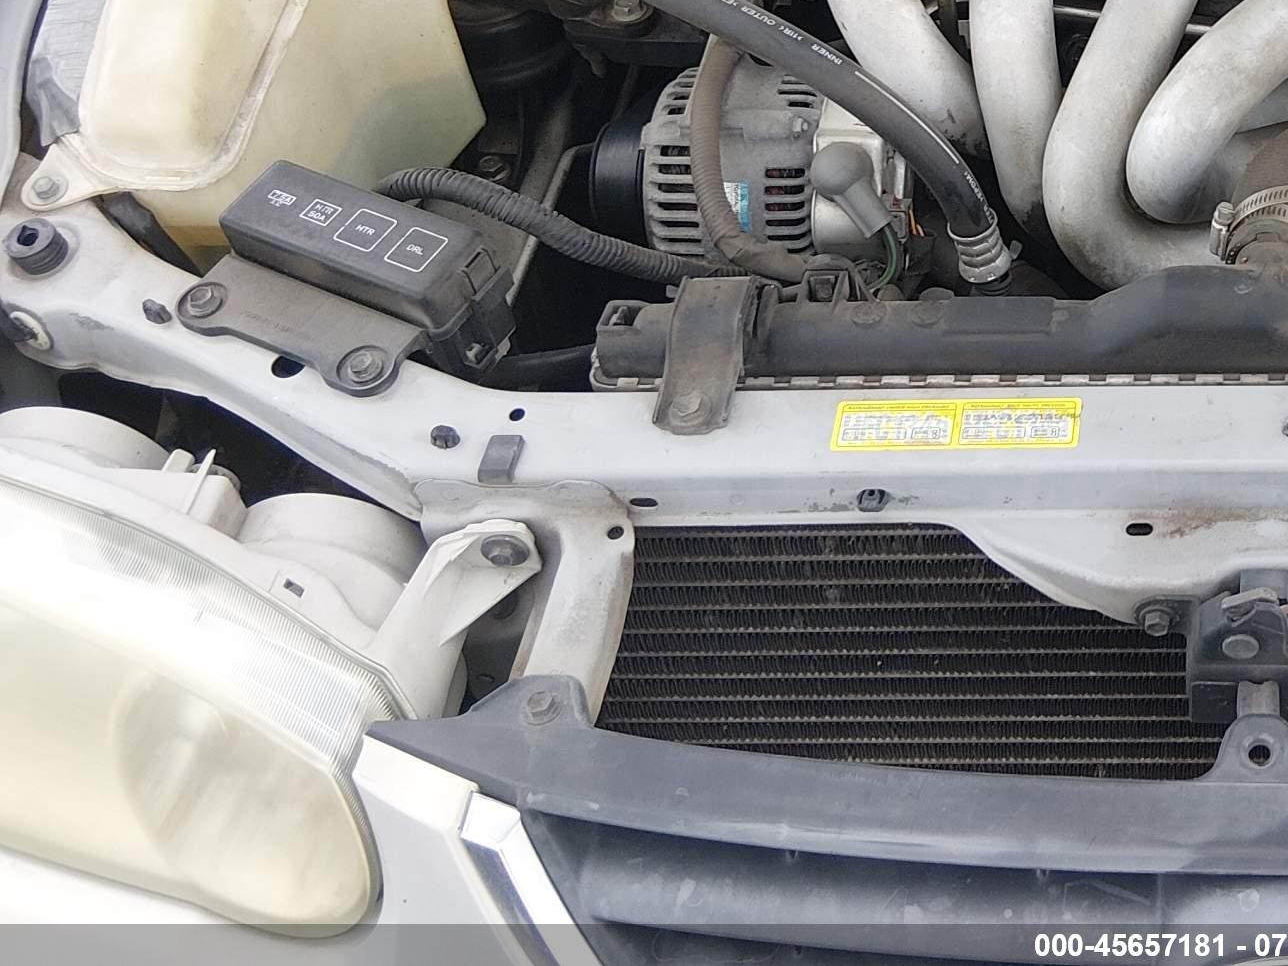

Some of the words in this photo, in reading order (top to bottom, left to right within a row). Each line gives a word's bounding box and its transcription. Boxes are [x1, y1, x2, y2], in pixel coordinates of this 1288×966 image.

[740, 6, 776, 26] OUTER
[810, 43, 843, 65] INNER
[314, 204, 334, 214] HTR
[355, 224, 376, 236] HTR
[405, 244, 424, 256] DRL
